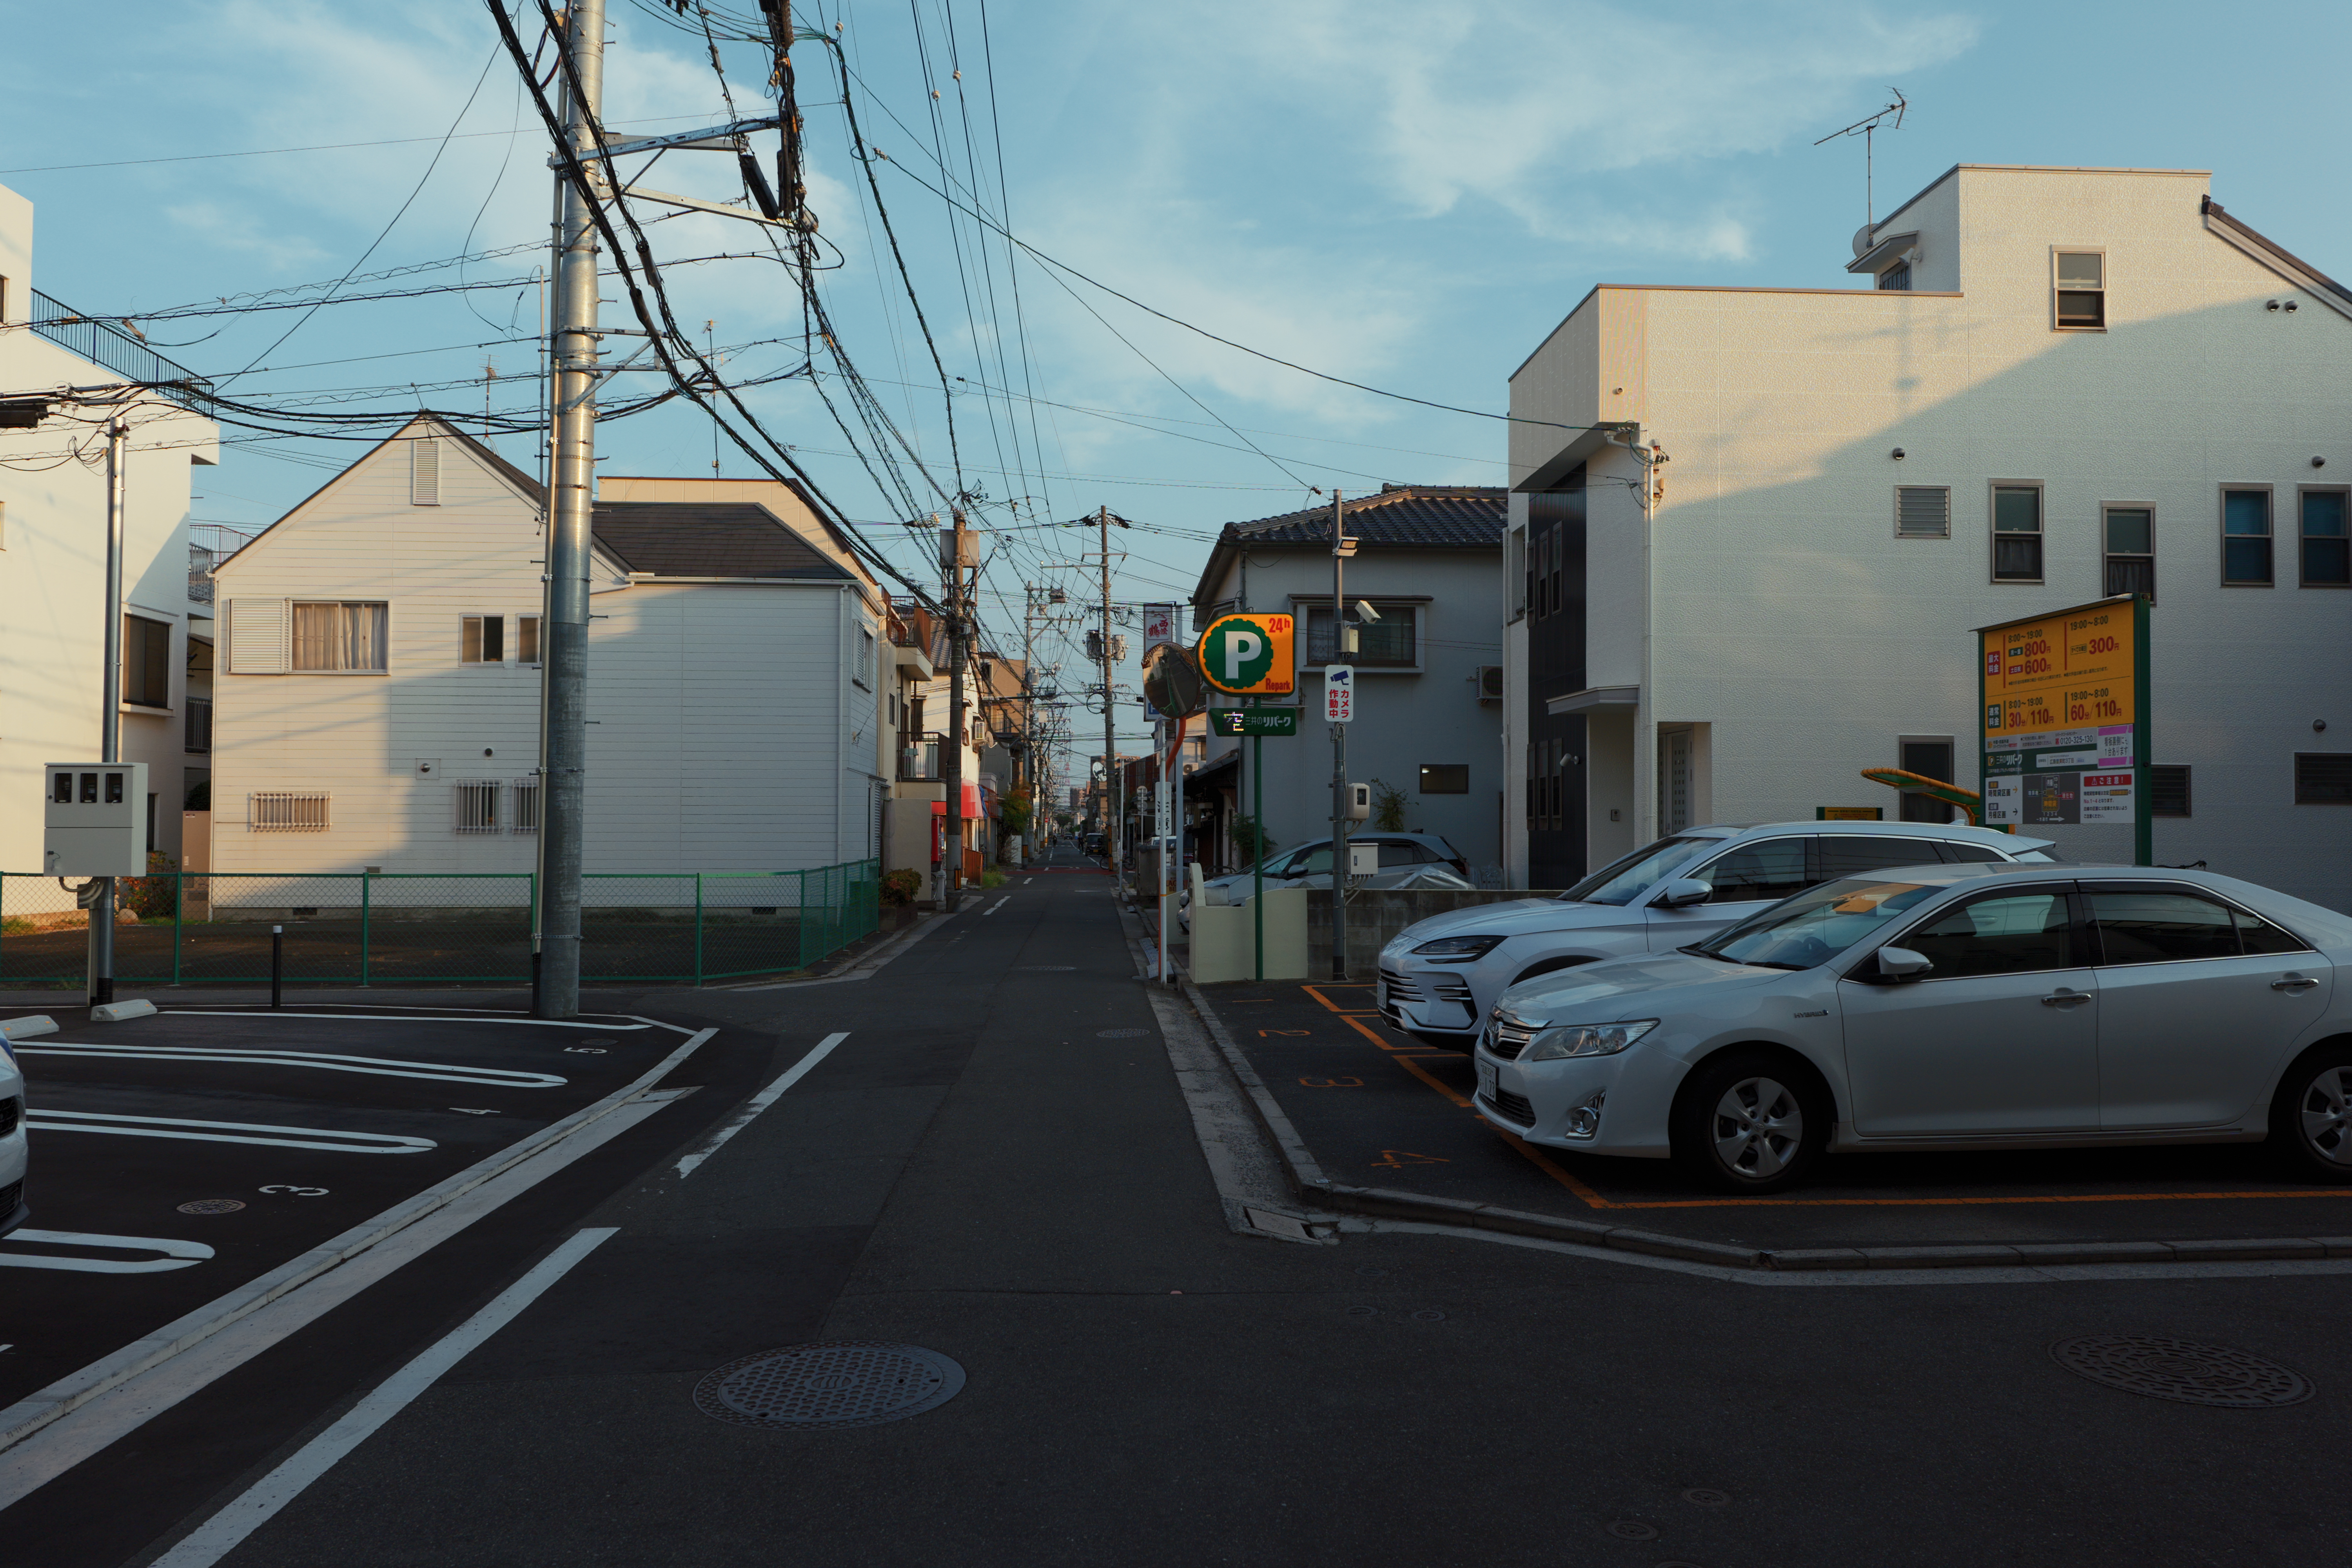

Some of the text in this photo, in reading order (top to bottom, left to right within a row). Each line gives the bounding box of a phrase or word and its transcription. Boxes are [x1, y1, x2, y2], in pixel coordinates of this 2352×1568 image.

[1269, 618, 1290, 633] 24h
[2025, 640, 2051, 657] 800円
[2089, 636, 2119, 655] 300円
[1225, 631, 1262, 679] P
[1989, 654, 1999, 663] 最大
[1989, 664, 1999, 673] 料金
[2025, 658, 2051, 675] 600円
[1266, 678, 1290, 692] Repark
[1329, 689, 1338, 718] 作動中
[1245, 716, 1291, 727] 三井のリパーク
[2060, 735, 2092, 744] 0120-325-130
[1996, 753, 2022, 765] 三井のリパーク
[1794, 1009, 1825, 1018] HYBRID
